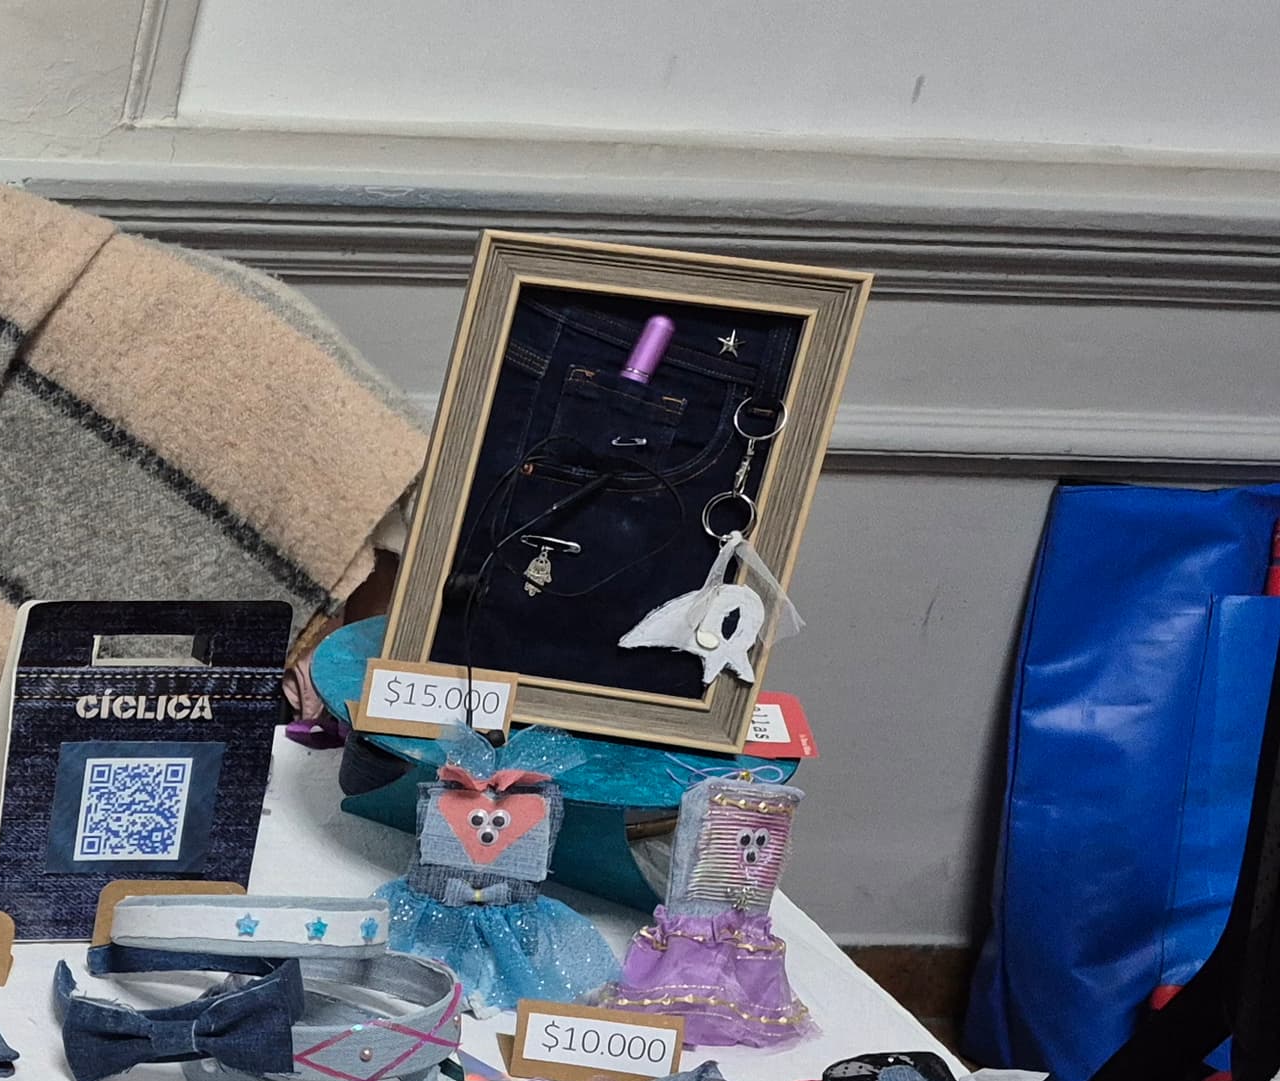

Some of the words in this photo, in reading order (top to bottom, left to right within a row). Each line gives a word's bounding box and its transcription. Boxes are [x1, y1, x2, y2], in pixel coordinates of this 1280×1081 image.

[75, 688, 213, 721] CÍCLICA
[383, 675, 500, 715] $15.000
[541, 1020, 667, 1063] $10.000
